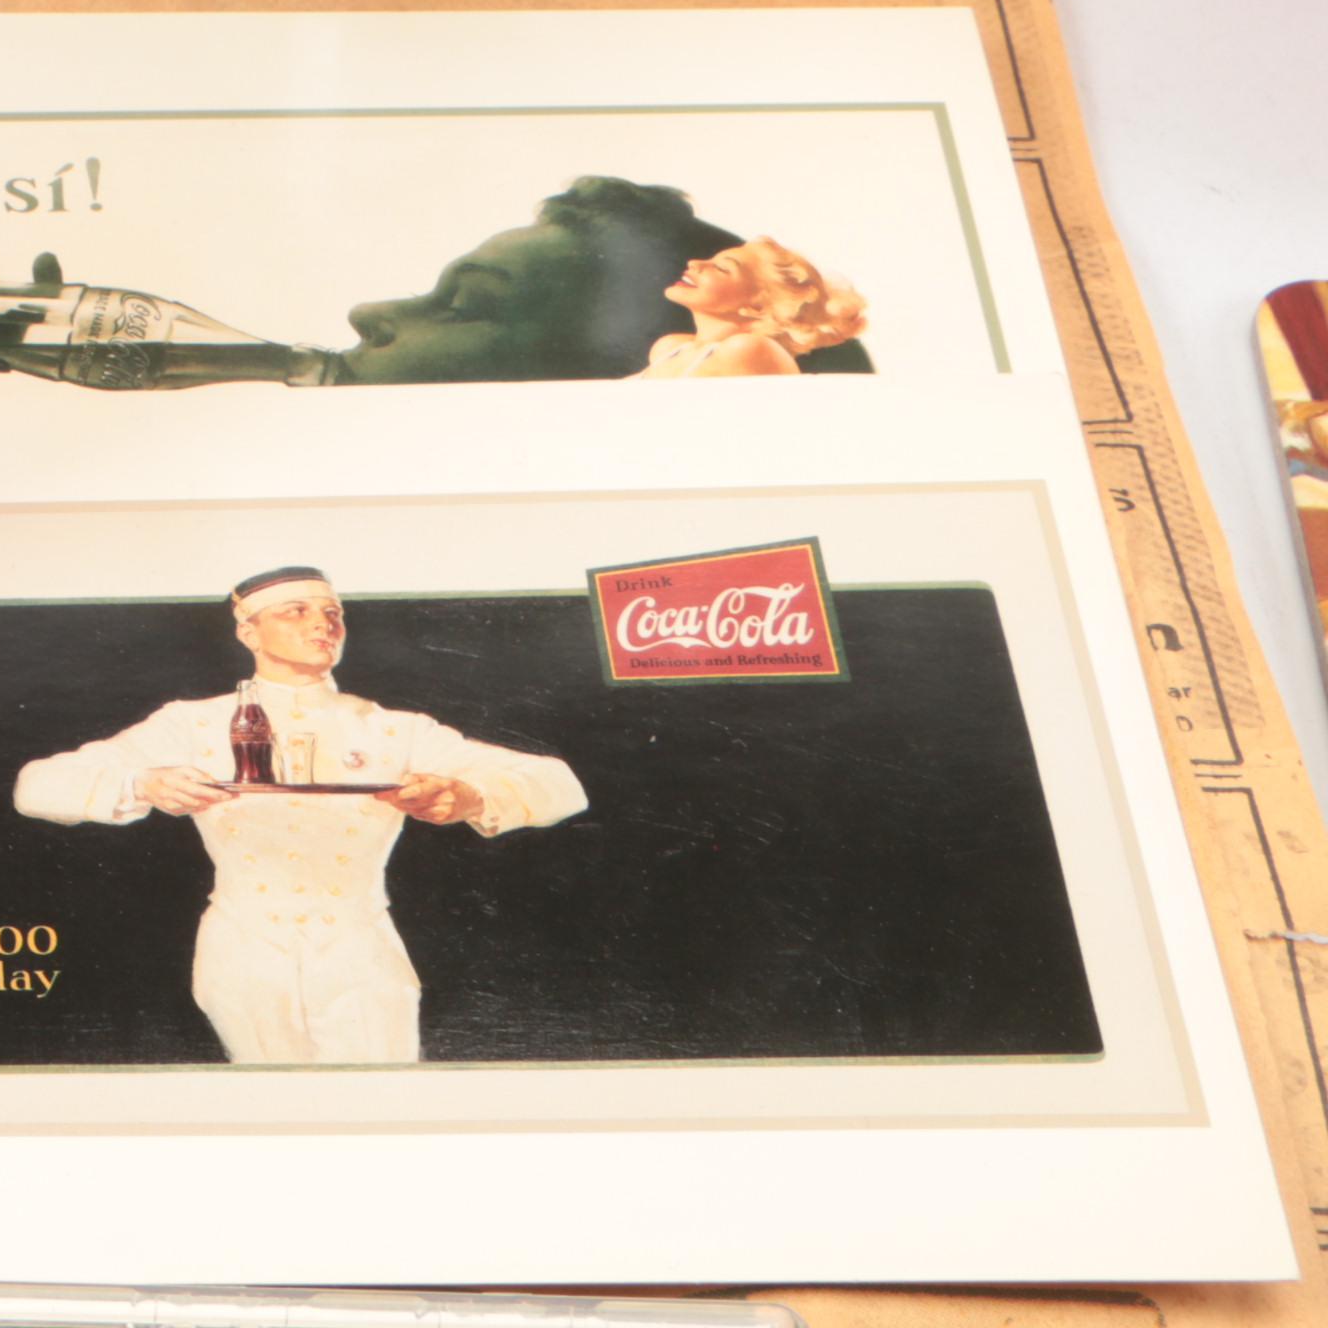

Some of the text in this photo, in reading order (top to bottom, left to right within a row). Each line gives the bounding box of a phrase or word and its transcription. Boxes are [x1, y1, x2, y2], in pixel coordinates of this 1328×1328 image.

[615, 575, 673, 593] Drink
[616, 582, 814, 652] Coca-Cola
[629, 651, 823, 670] Delicious and Refreshing
